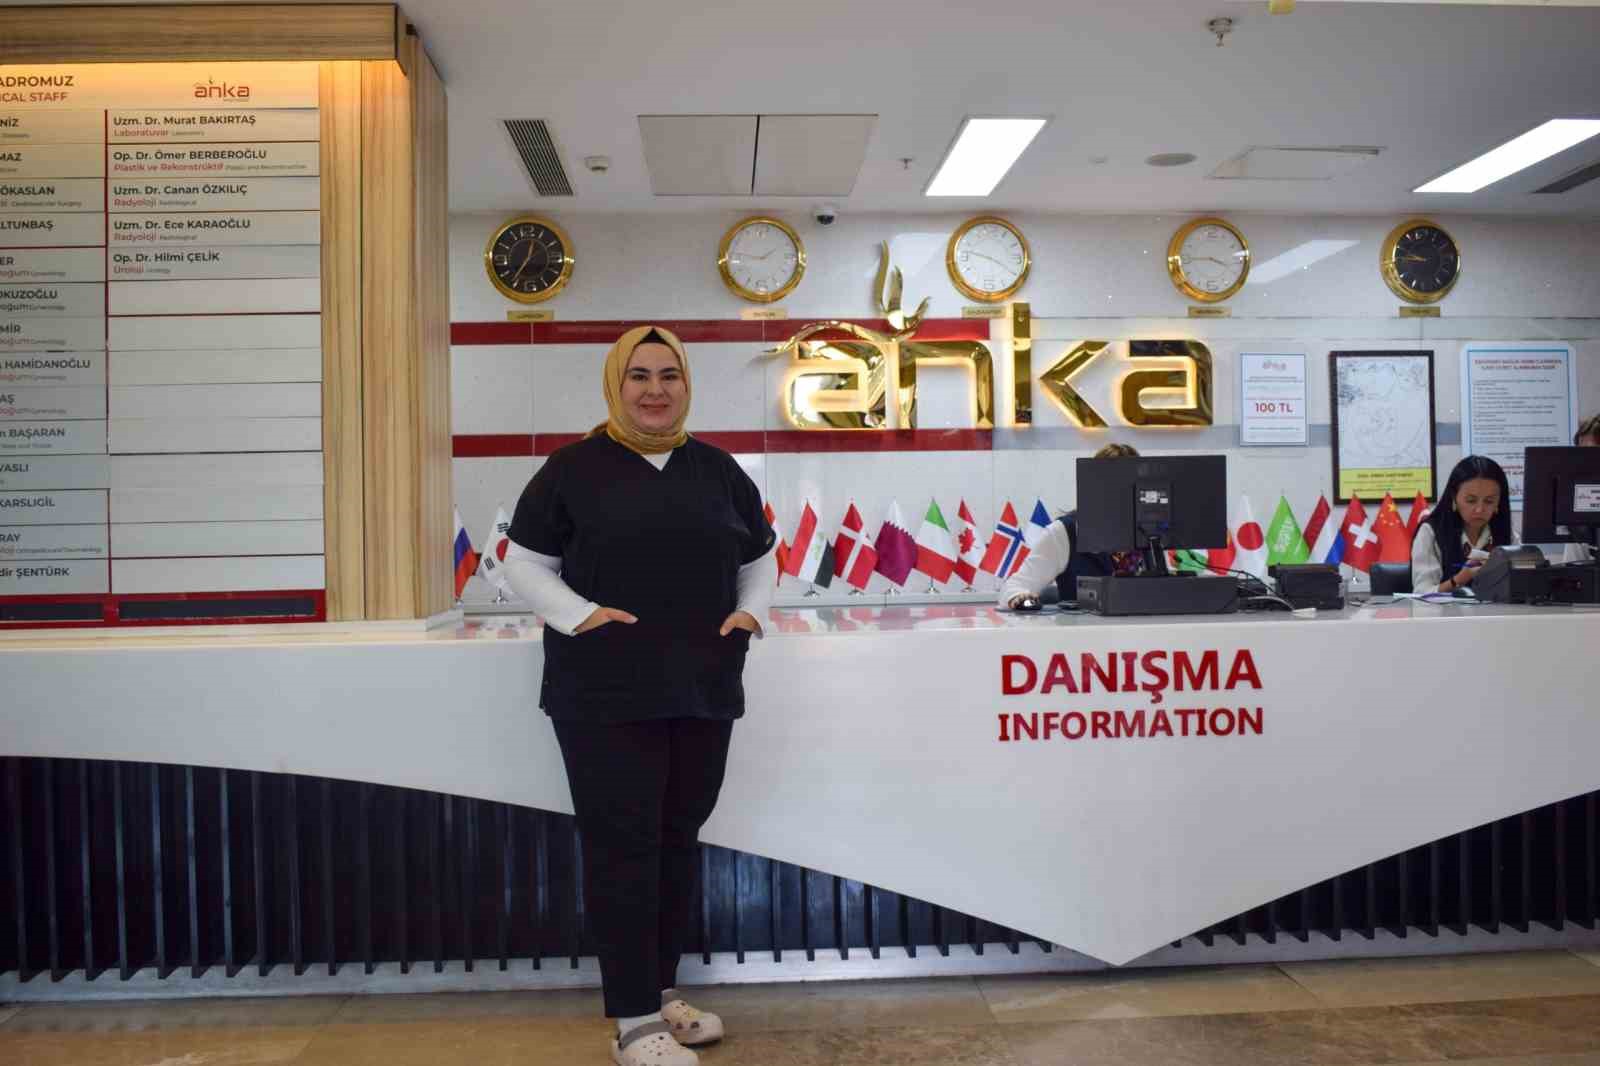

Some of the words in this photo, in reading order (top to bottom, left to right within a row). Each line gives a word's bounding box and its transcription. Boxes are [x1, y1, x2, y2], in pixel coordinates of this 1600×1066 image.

[30, 91, 68, 102] STAFF
[113, 117, 141, 125] Uzm.
[145, 117, 160, 125] Dr.
[164, 116, 196, 125] Murat
[199, 115, 256, 125] BAKIRTAŞ
[113, 151, 132, 162] Op.
[136, 151, 152, 160] Dr.
[155, 149, 186, 160] Ömer
[190, 149, 267, 160] BERBEROĞLU
[114, 163, 144, 172] Plastik
[113, 186, 141, 195] Uzm.
[145, 186, 160, 194] Dr.
[164, 186, 199, 194] Canan
[202, 184, 248, 195] ÖZKILIÇ
[114, 221, 142, 229] Uzm.
[145, 221, 160, 229] Dr.
[164, 220, 184, 228] Ece
[187, 219, 250, 229] KARAOĞLU
[113, 254, 132, 264] Op.
[136, 254, 152, 262] Dr.
[155, 252, 184, 262] Hilmi
[187, 250, 220, 262] ÇELİK
[5, 358, 90, 369] HAMİDANOĞLU
[789, 302, 1213, 428] anka
[1255, 403, 1276, 413] 100
[1279, 403, 1293, 412] TL
[9, 428, 65, 438] BAŞARAN
[16, 566, 70, 579] ŞENTÜRK
[1001, 649, 1263, 704] DANIŞMA
[998, 707, 1264, 741] INFORMATION
